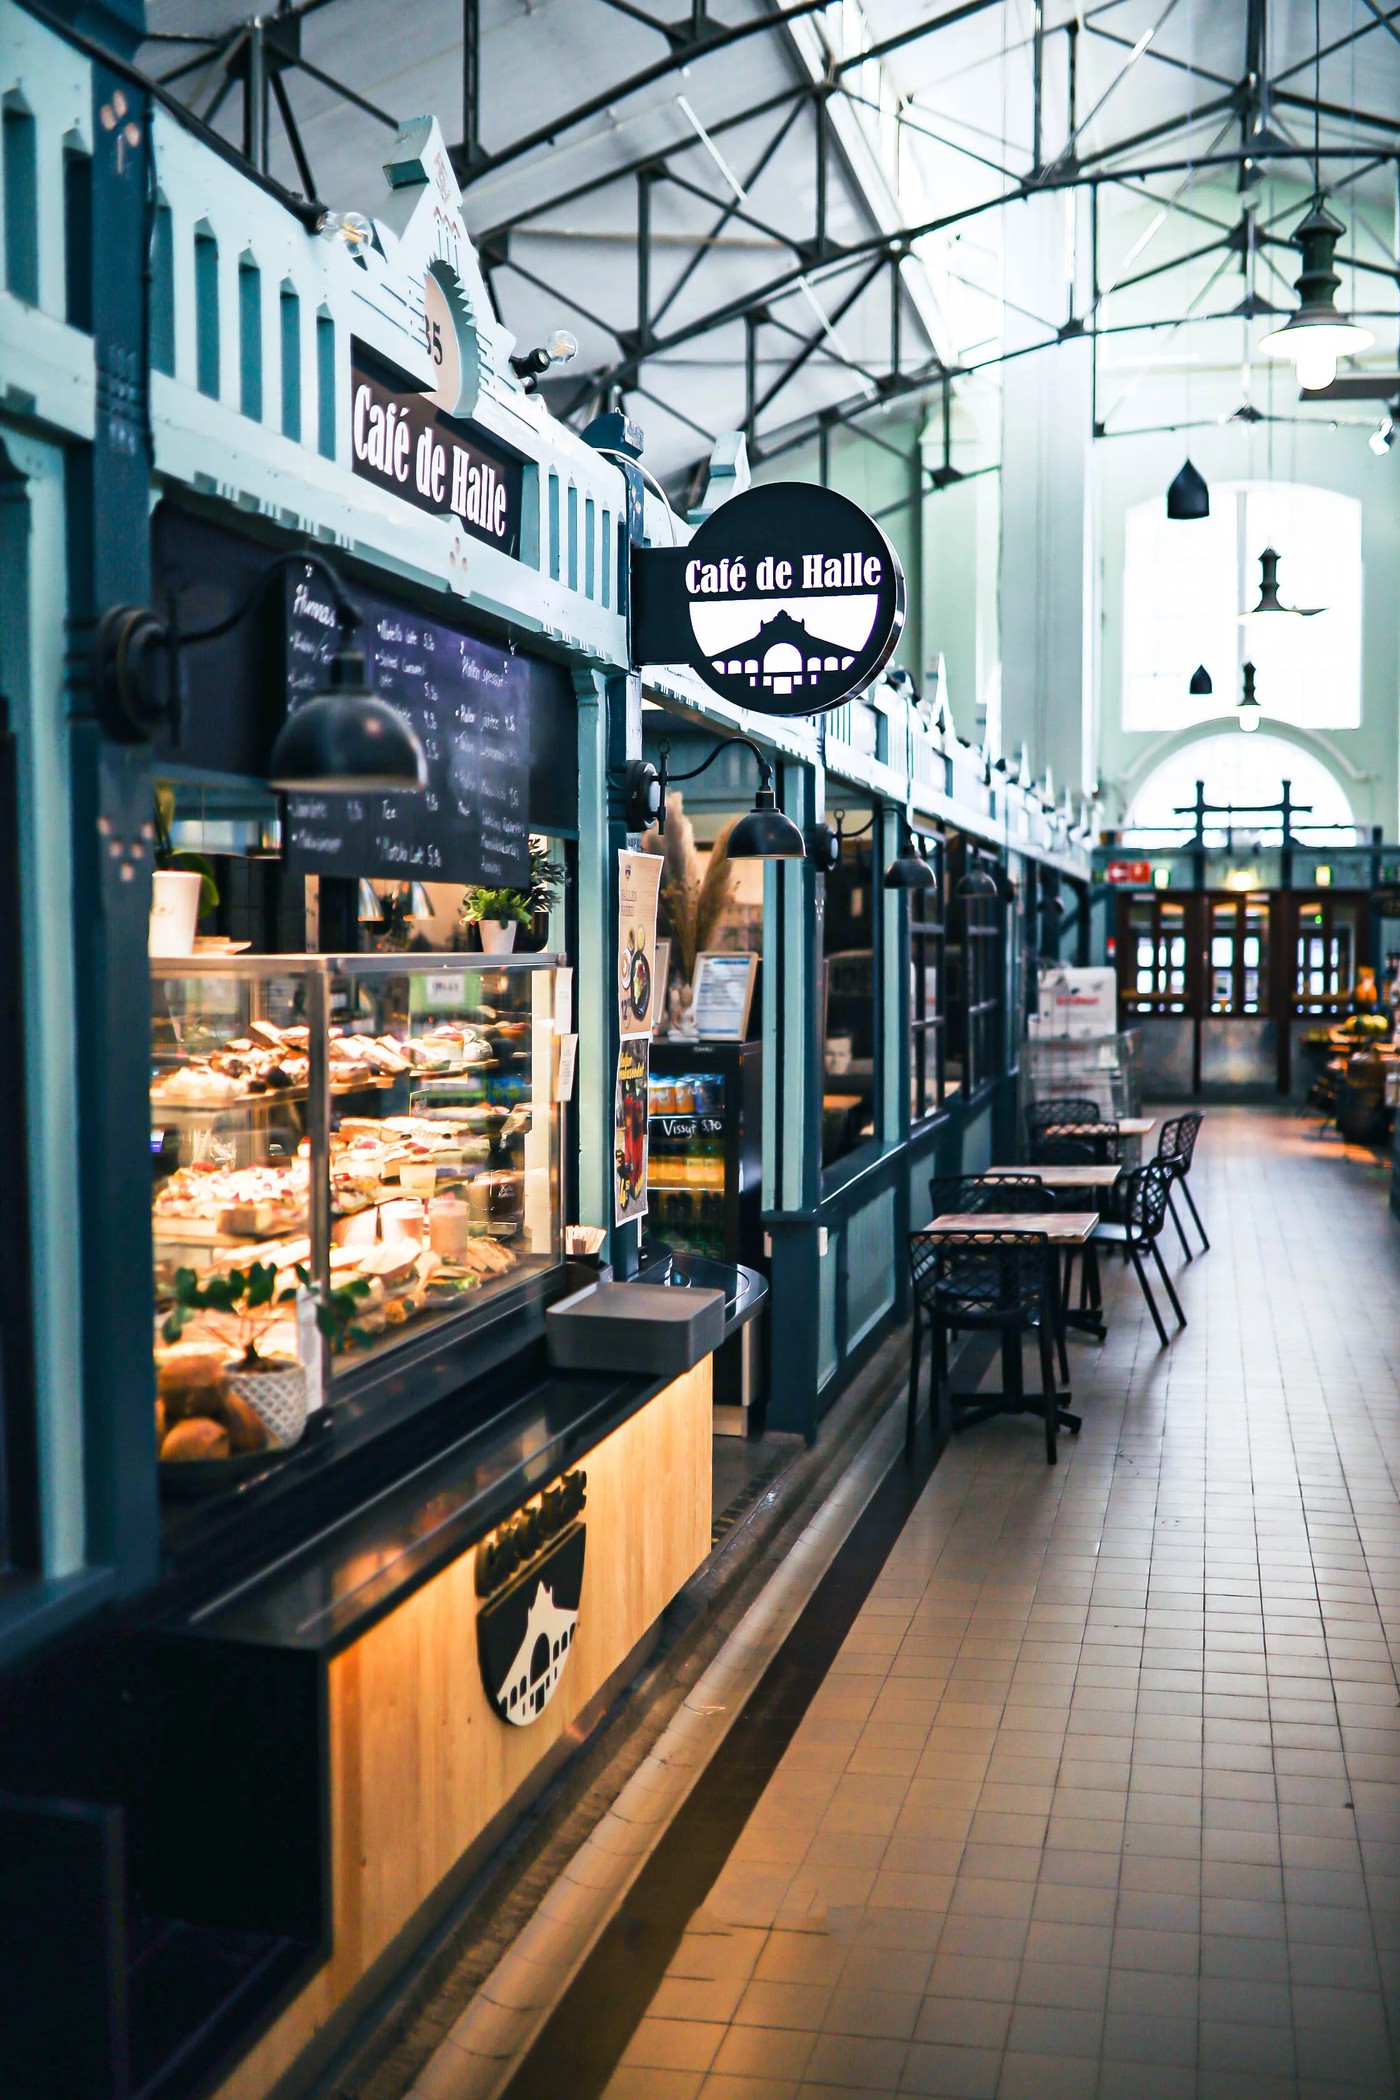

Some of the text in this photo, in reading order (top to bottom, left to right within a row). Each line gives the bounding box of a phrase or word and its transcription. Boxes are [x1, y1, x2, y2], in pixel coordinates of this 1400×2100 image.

[353, 384, 507, 538] Café de Halle
[685, 552, 882, 594] Café de Halle
[701, 1119, 722, 1132] 3,70
